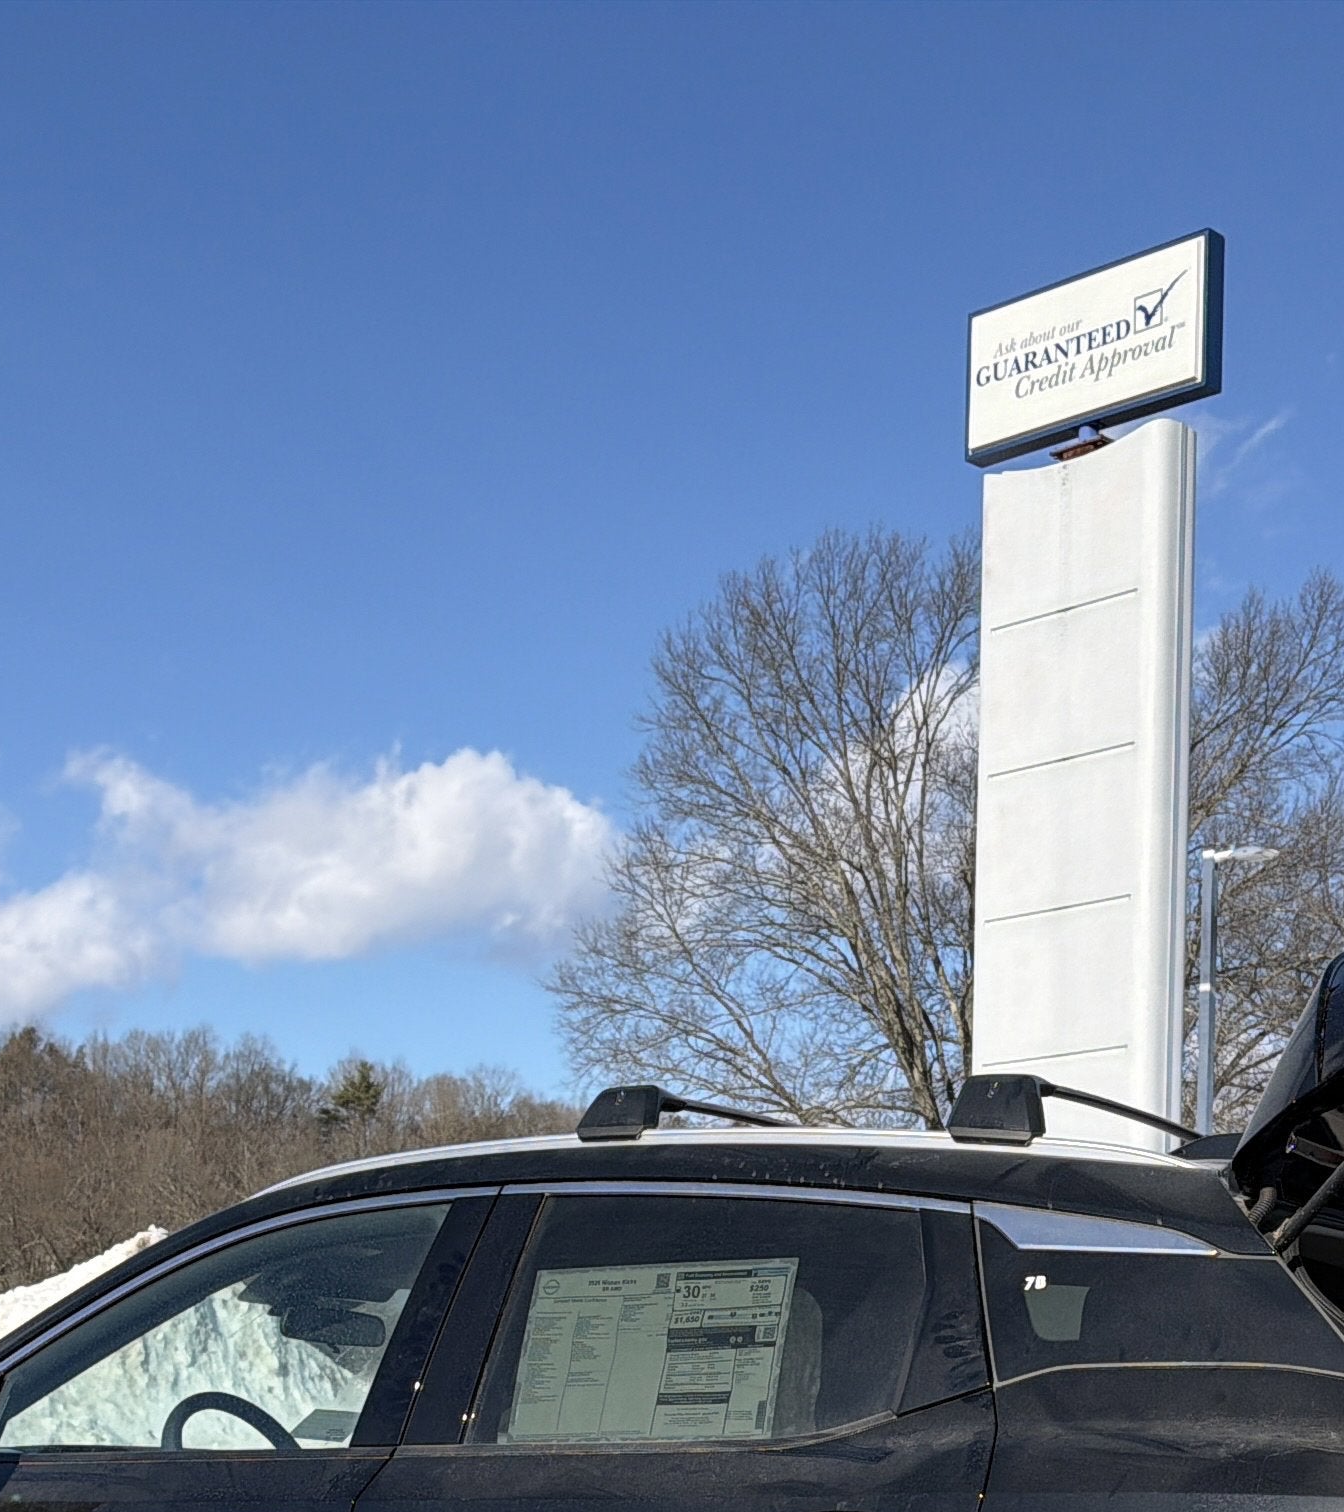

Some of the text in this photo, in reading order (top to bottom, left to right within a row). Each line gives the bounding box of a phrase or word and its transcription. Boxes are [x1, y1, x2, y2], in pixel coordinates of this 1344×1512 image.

[976, 318, 1131, 388] GUARANTEED
[993, 319, 1083, 360] Ask about our
[1014, 324, 1176, 399] Credit Approval
[682, 1285, 701, 1299] 30
